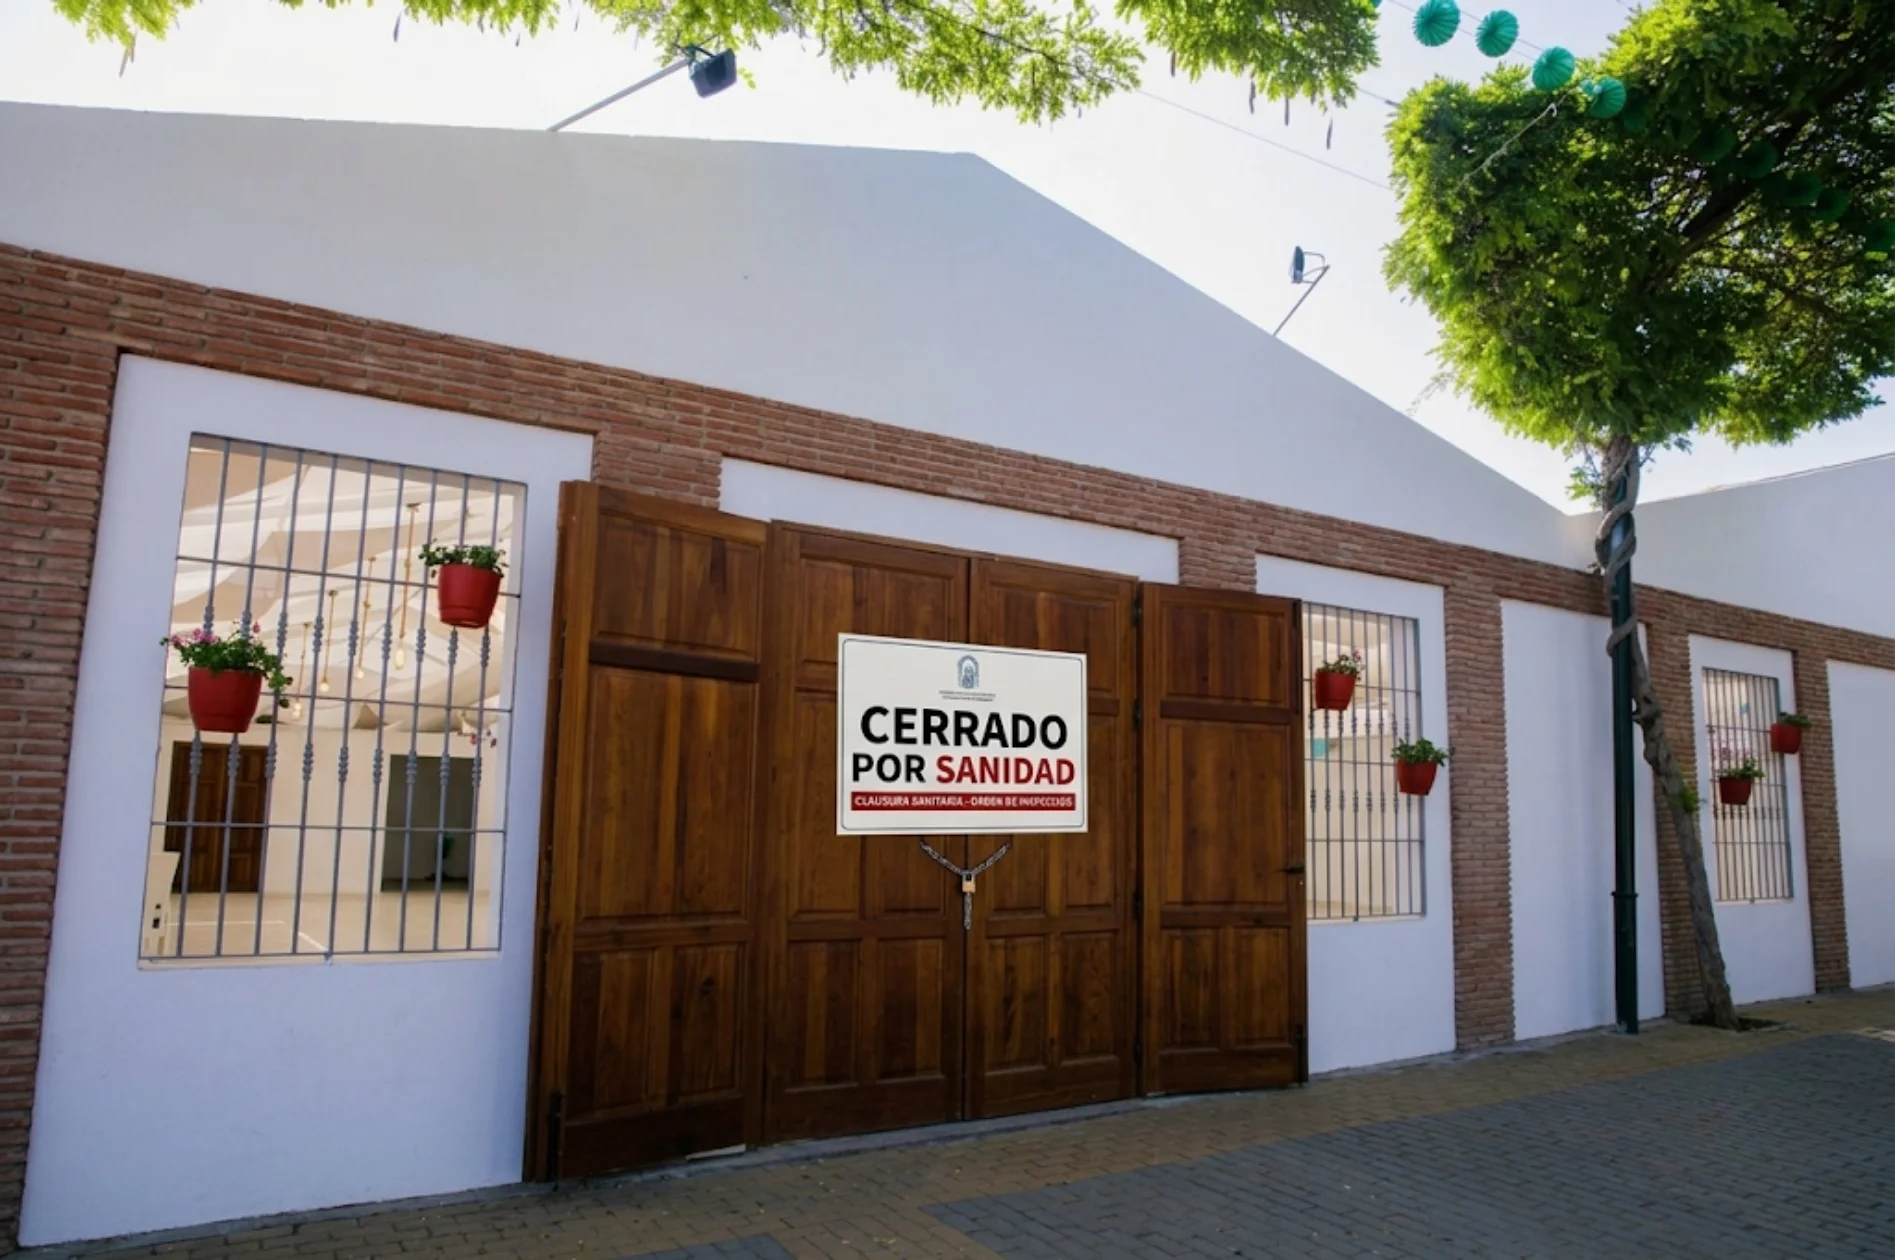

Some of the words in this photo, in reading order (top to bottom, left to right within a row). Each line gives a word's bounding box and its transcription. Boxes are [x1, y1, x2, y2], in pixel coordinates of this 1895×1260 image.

[861, 705, 1068, 750] CERRADO
[852, 751, 926, 783] POR
[936, 754, 1076, 785] SANIDAD
[854, 795, 910, 807] CLAUSURA
[911, 795, 963, 808] SANITARIA
[971, 796, 1003, 808] ORDEN
